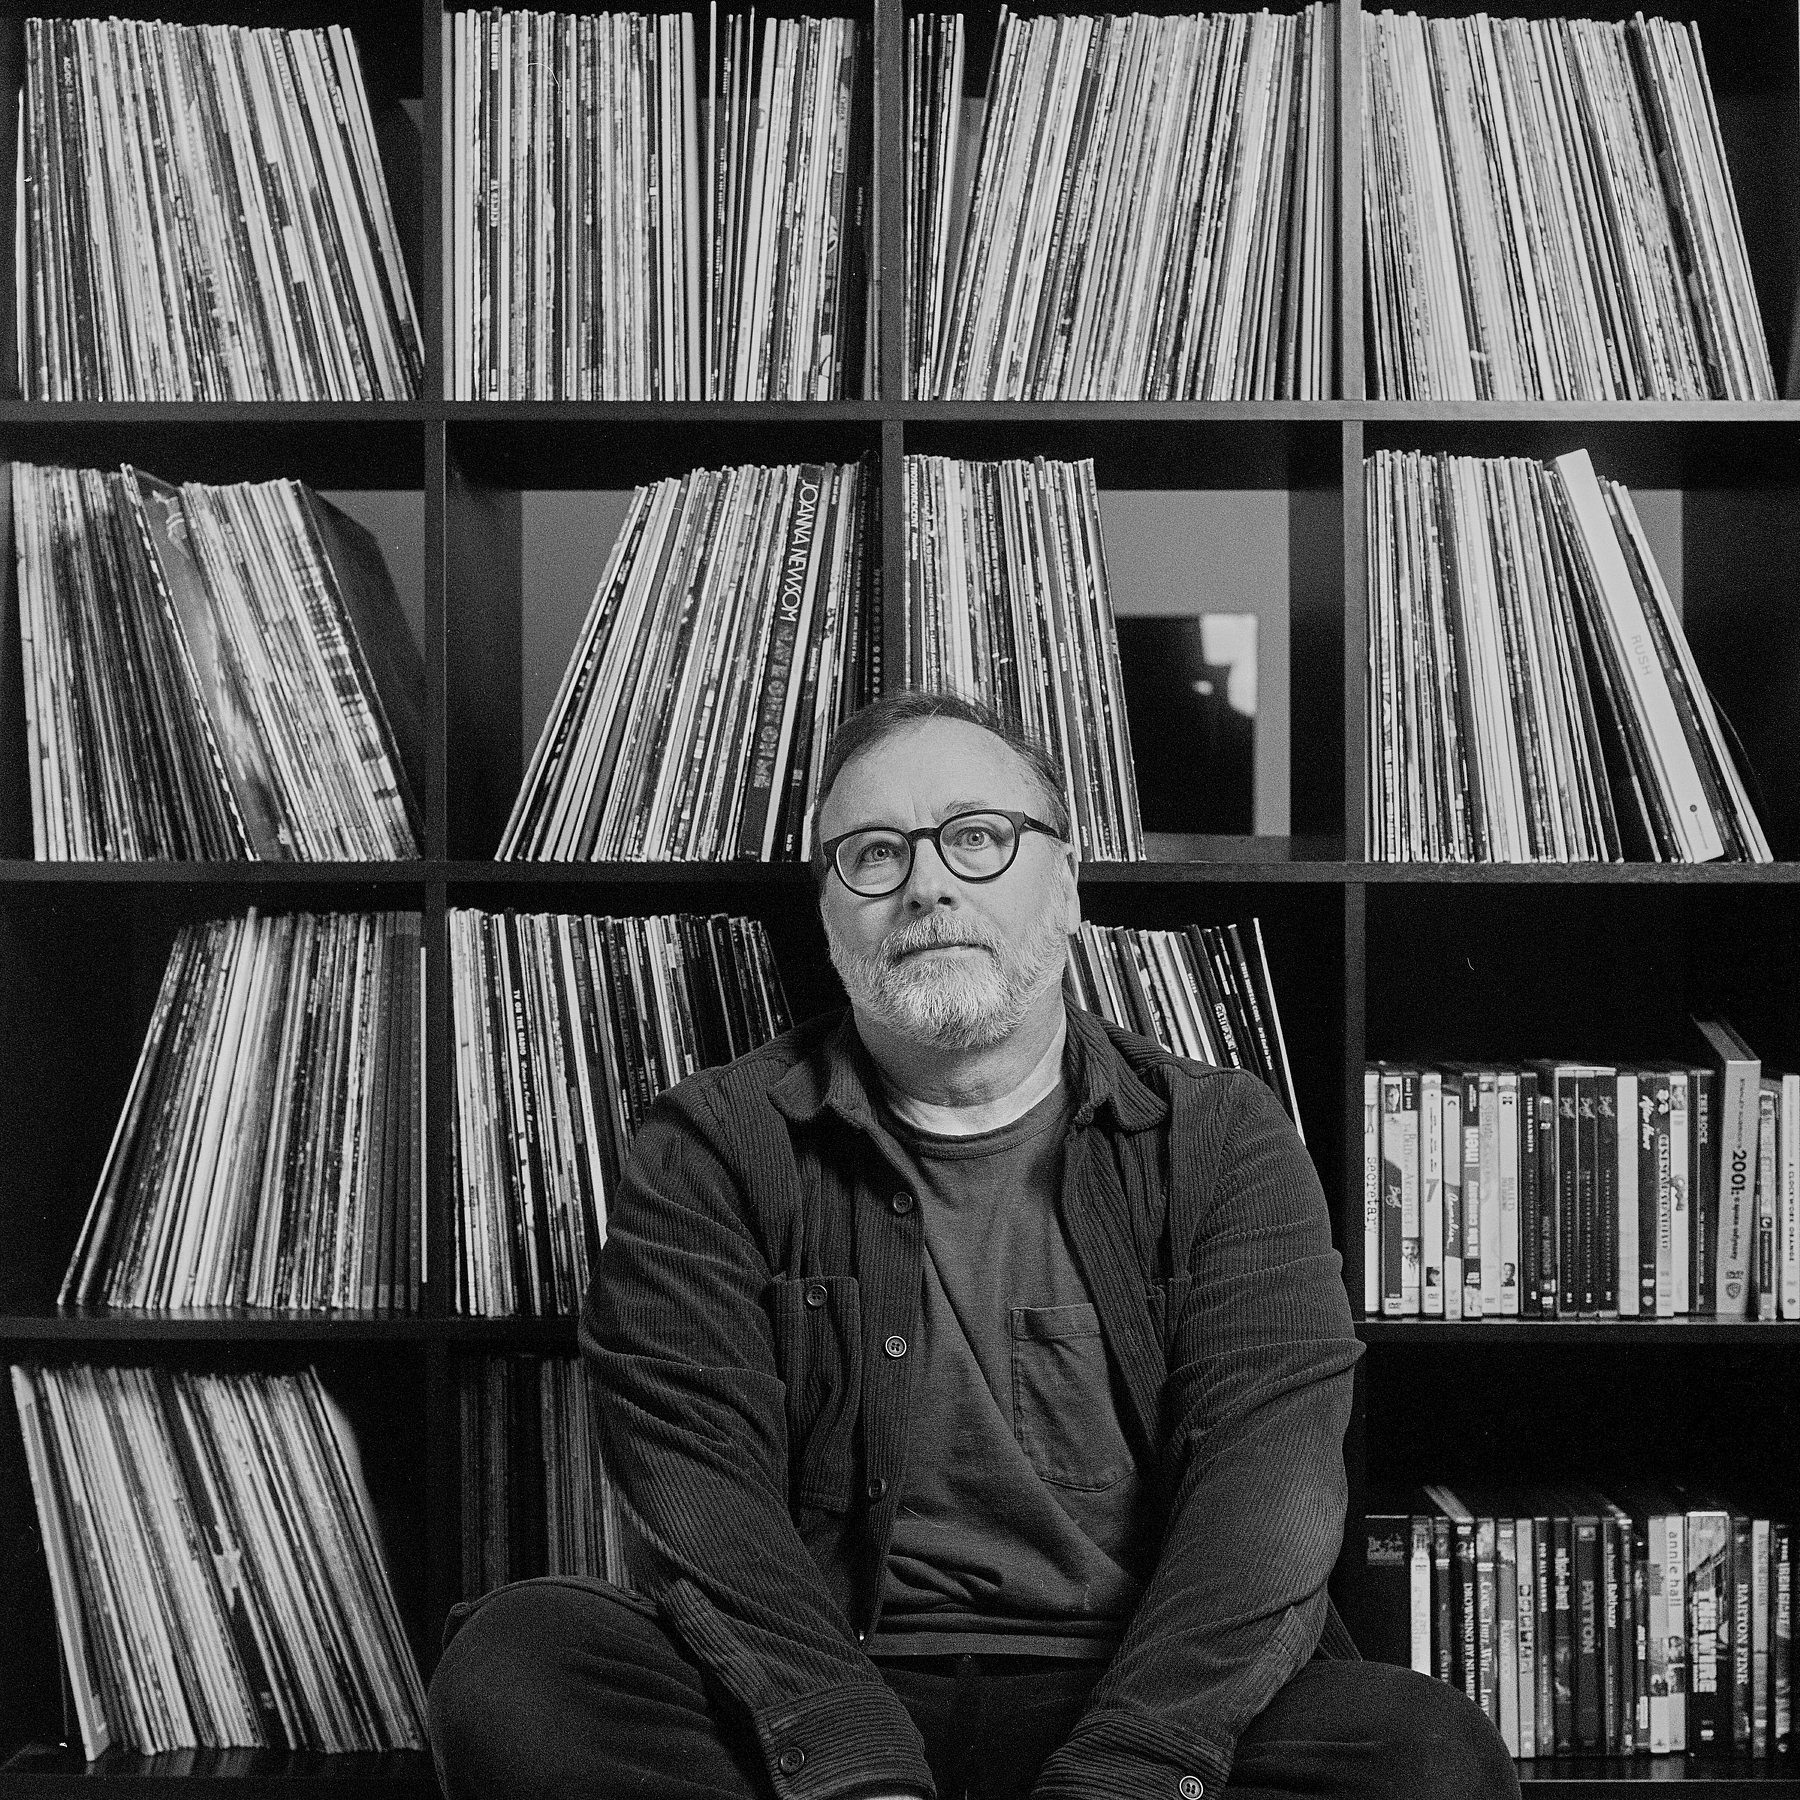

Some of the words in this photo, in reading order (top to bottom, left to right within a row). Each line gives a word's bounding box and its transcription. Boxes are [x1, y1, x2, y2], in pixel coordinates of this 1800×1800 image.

[790, 479, 820, 547] JOANNA
[909, 462, 919, 527] PHOSPHORESCENT
[777, 547, 809, 622] NEWSOM
[1629, 633, 1653, 676] RUSH
[512, 988, 520, 1000] TV
[514, 1000, 522, 1013] ON
[1239, 961, 1249, 978] THIS
[1244, 978, 1256, 1005] MORTAL
[1251, 1004, 1261, 1022] COIL
[515, 1015, 524, 1029] THE
[517, 1031, 527, 1055] RADIO
[1638, 1095, 1654, 1123] After
[1700, 1092, 1708, 1112] THE
[1464, 1127, 1478, 1162] men
[1699, 1114, 1708, 1143] ROCK
[1658, 1134, 1669, 1182] CINEMA
[1731, 1149, 1747, 1195] 2001:
[1364, 1156, 1377, 1235] secretary
[1468, 1179, 1478, 1225] company
[1659, 1182, 1671, 1249] PARADISO
[1669, 1531, 1680, 1574] annie
[1670, 1579, 1681, 1606] hall
[1778, 1562, 1789, 1591] IRON
[1462, 1582, 1475, 1642] DROWNING
[1582, 1580, 1594, 1653] PATTON
[1608, 1583, 1617, 1628] Balthazar
[1698, 1587, 1716, 1630] THE
[1736, 1583, 1748, 1645] BARTON
[1778, 1592, 1789, 1623] GIANT
[1464, 1643, 1474, 1657] BY
[1698, 1632, 1716, 1692] WIRE
[1737, 1647, 1749, 1684] FINK
